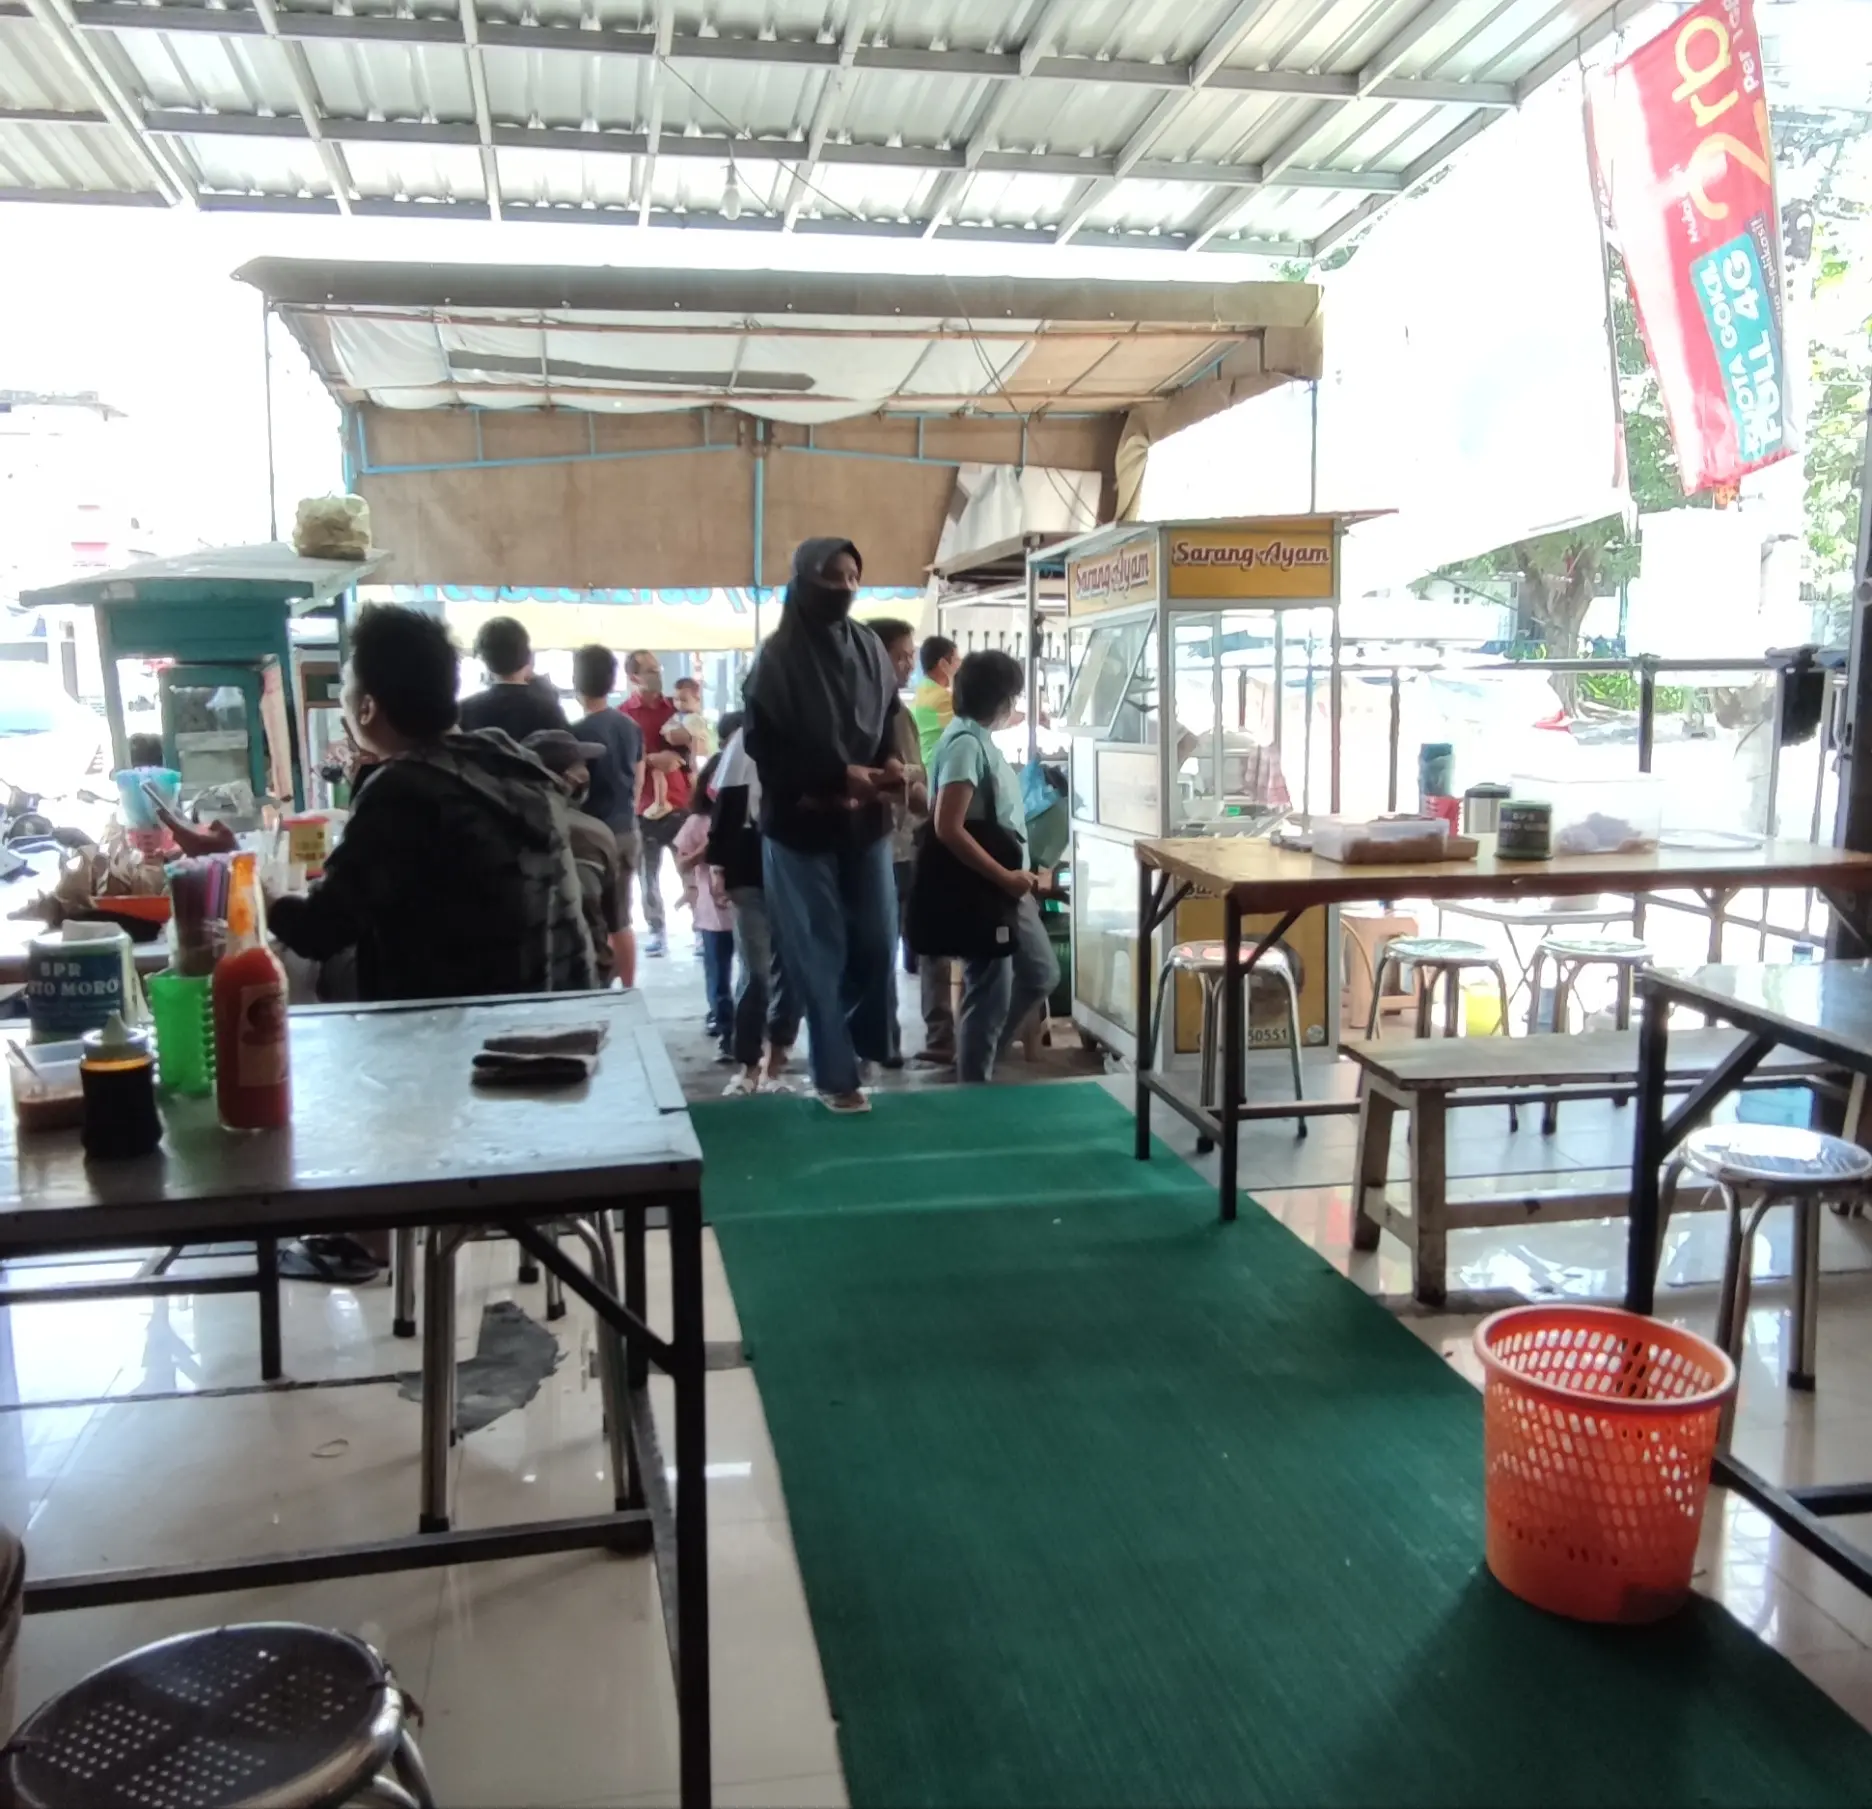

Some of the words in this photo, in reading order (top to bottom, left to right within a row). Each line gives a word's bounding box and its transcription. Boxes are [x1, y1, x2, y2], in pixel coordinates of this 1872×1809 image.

[1738, 50, 1760, 95] Per
[1750, 216, 1778, 289] Aplikasi!
[1699, 259, 1738, 349] GOKIL
[1722, 249, 1760, 321] 4G
[1748, 328, 1783, 444] FULL
[1076, 563, 1111, 602] Sarang
[1111, 548, 1149, 599] Ayam
[1173, 541, 1255, 571] Sarang
[1256, 540, 1330, 571] Ayam
[61, 978, 120, 996] MORO
